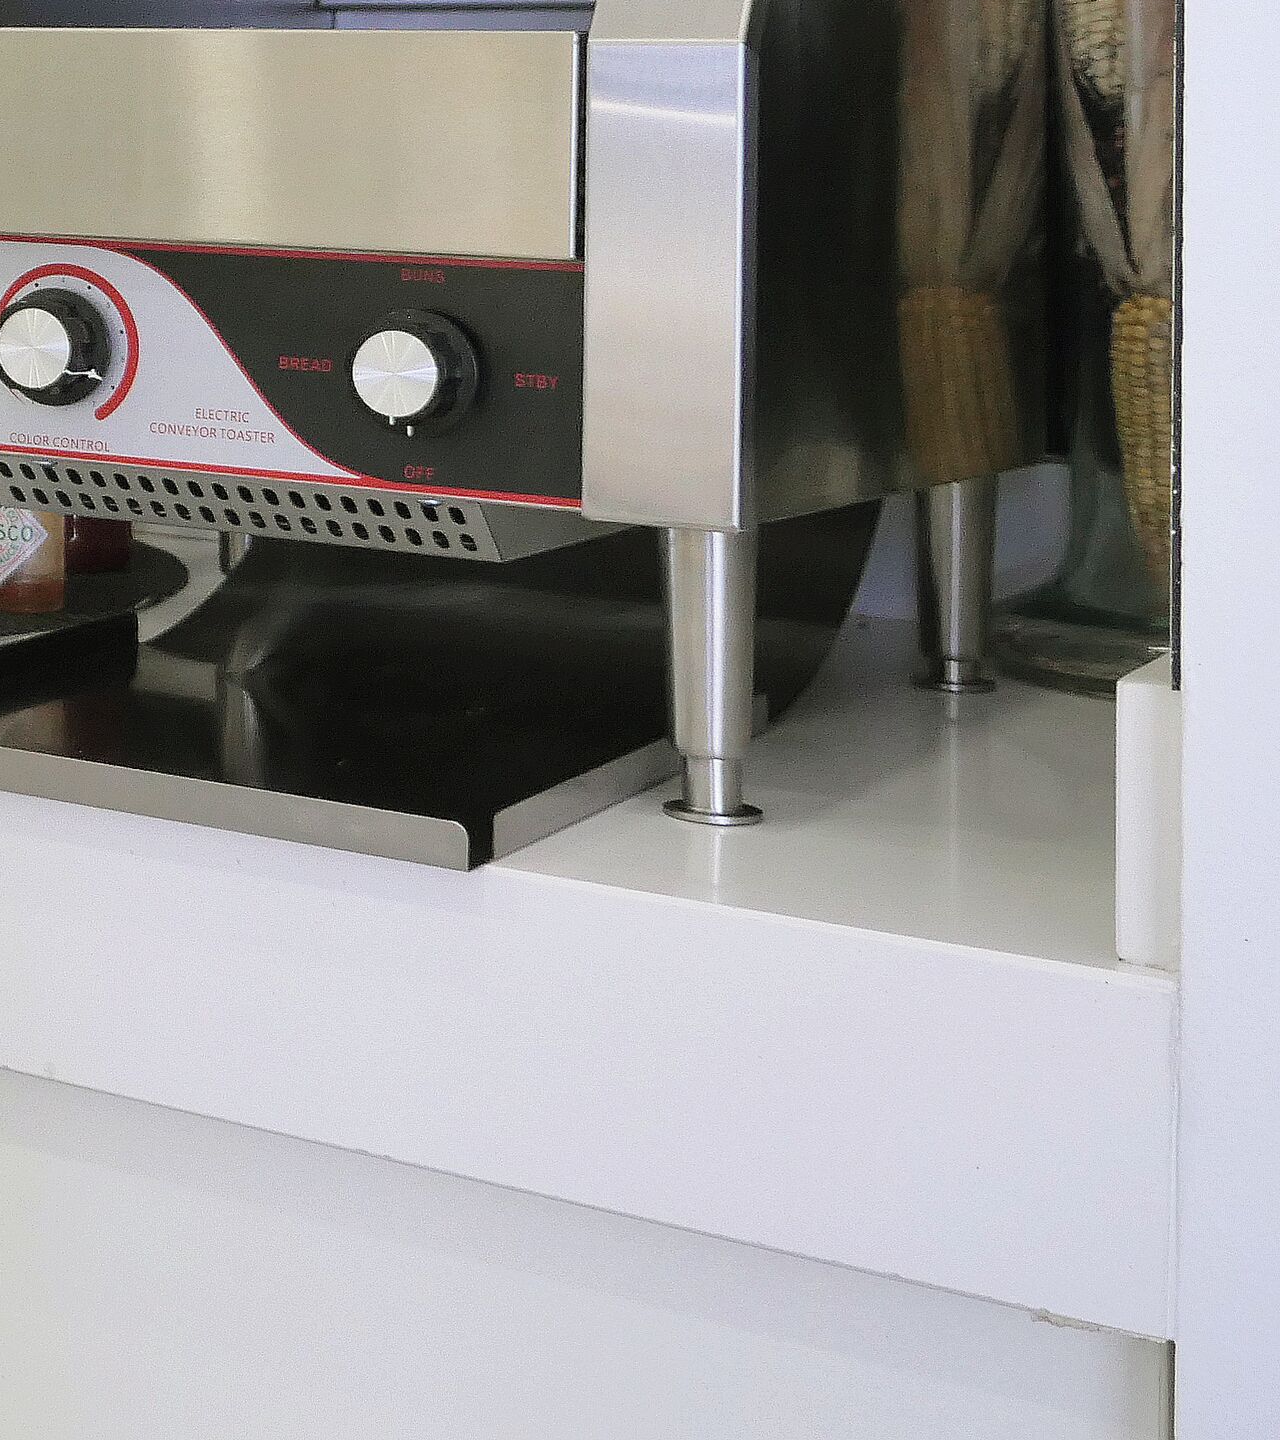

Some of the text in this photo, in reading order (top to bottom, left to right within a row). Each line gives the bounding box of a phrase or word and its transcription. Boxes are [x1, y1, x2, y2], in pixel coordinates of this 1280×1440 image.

[400, 269, 446, 284] BUNS
[279, 356, 333, 373] BREAD
[514, 373, 559, 390] STBY
[194, 408, 250, 424] ELECTRIC
[149, 422, 276, 444] CONVEYOR TOASTER
[9, 432, 111, 452] COLOR CONTROL
[402, 465, 435, 480] OFF
